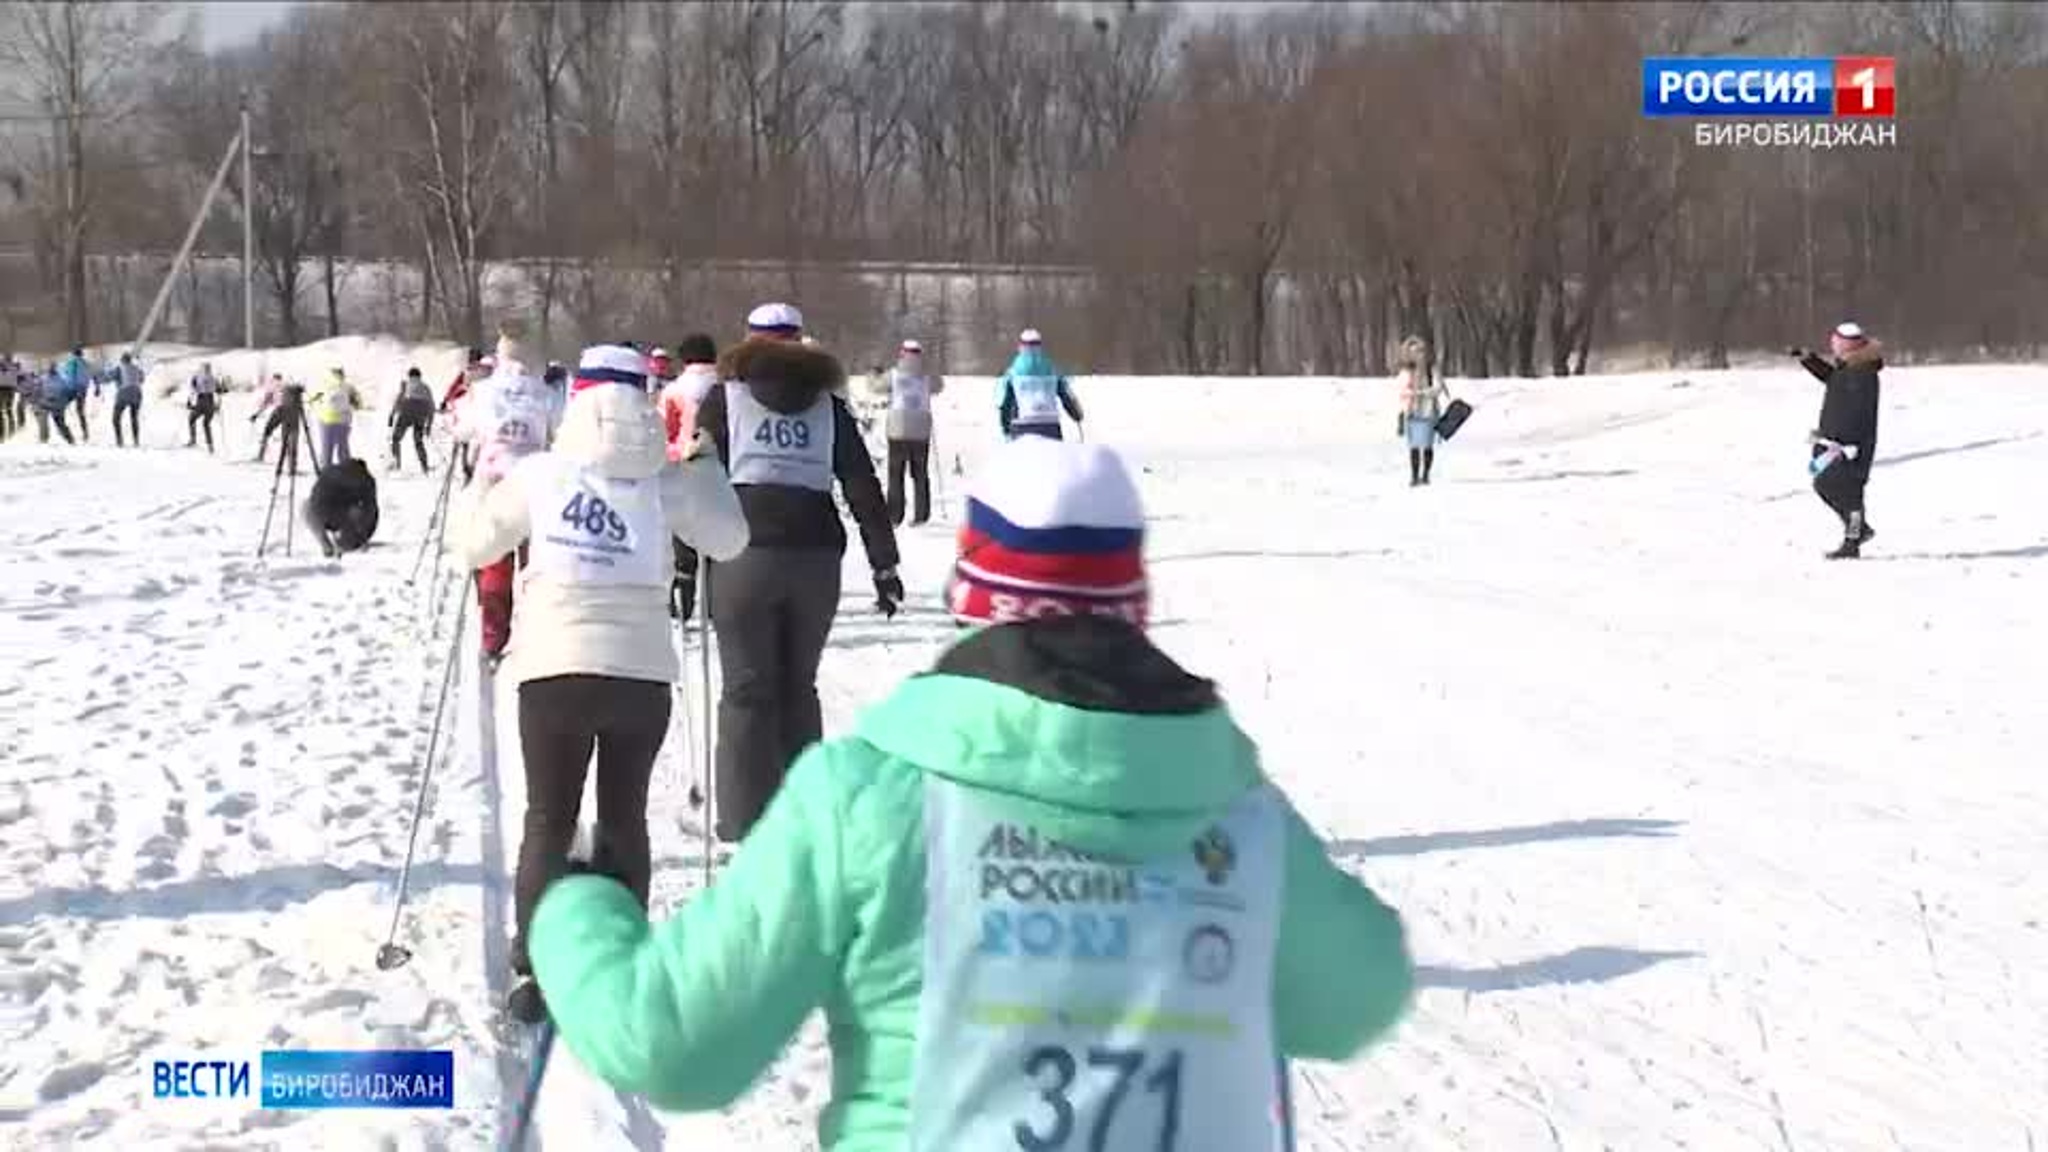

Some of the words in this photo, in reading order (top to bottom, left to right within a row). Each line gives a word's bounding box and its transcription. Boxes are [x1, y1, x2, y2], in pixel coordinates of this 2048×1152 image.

[754, 417, 810, 449] 469
[561, 491, 628, 541] 489
[1015, 1045, 1186, 1152] 371
